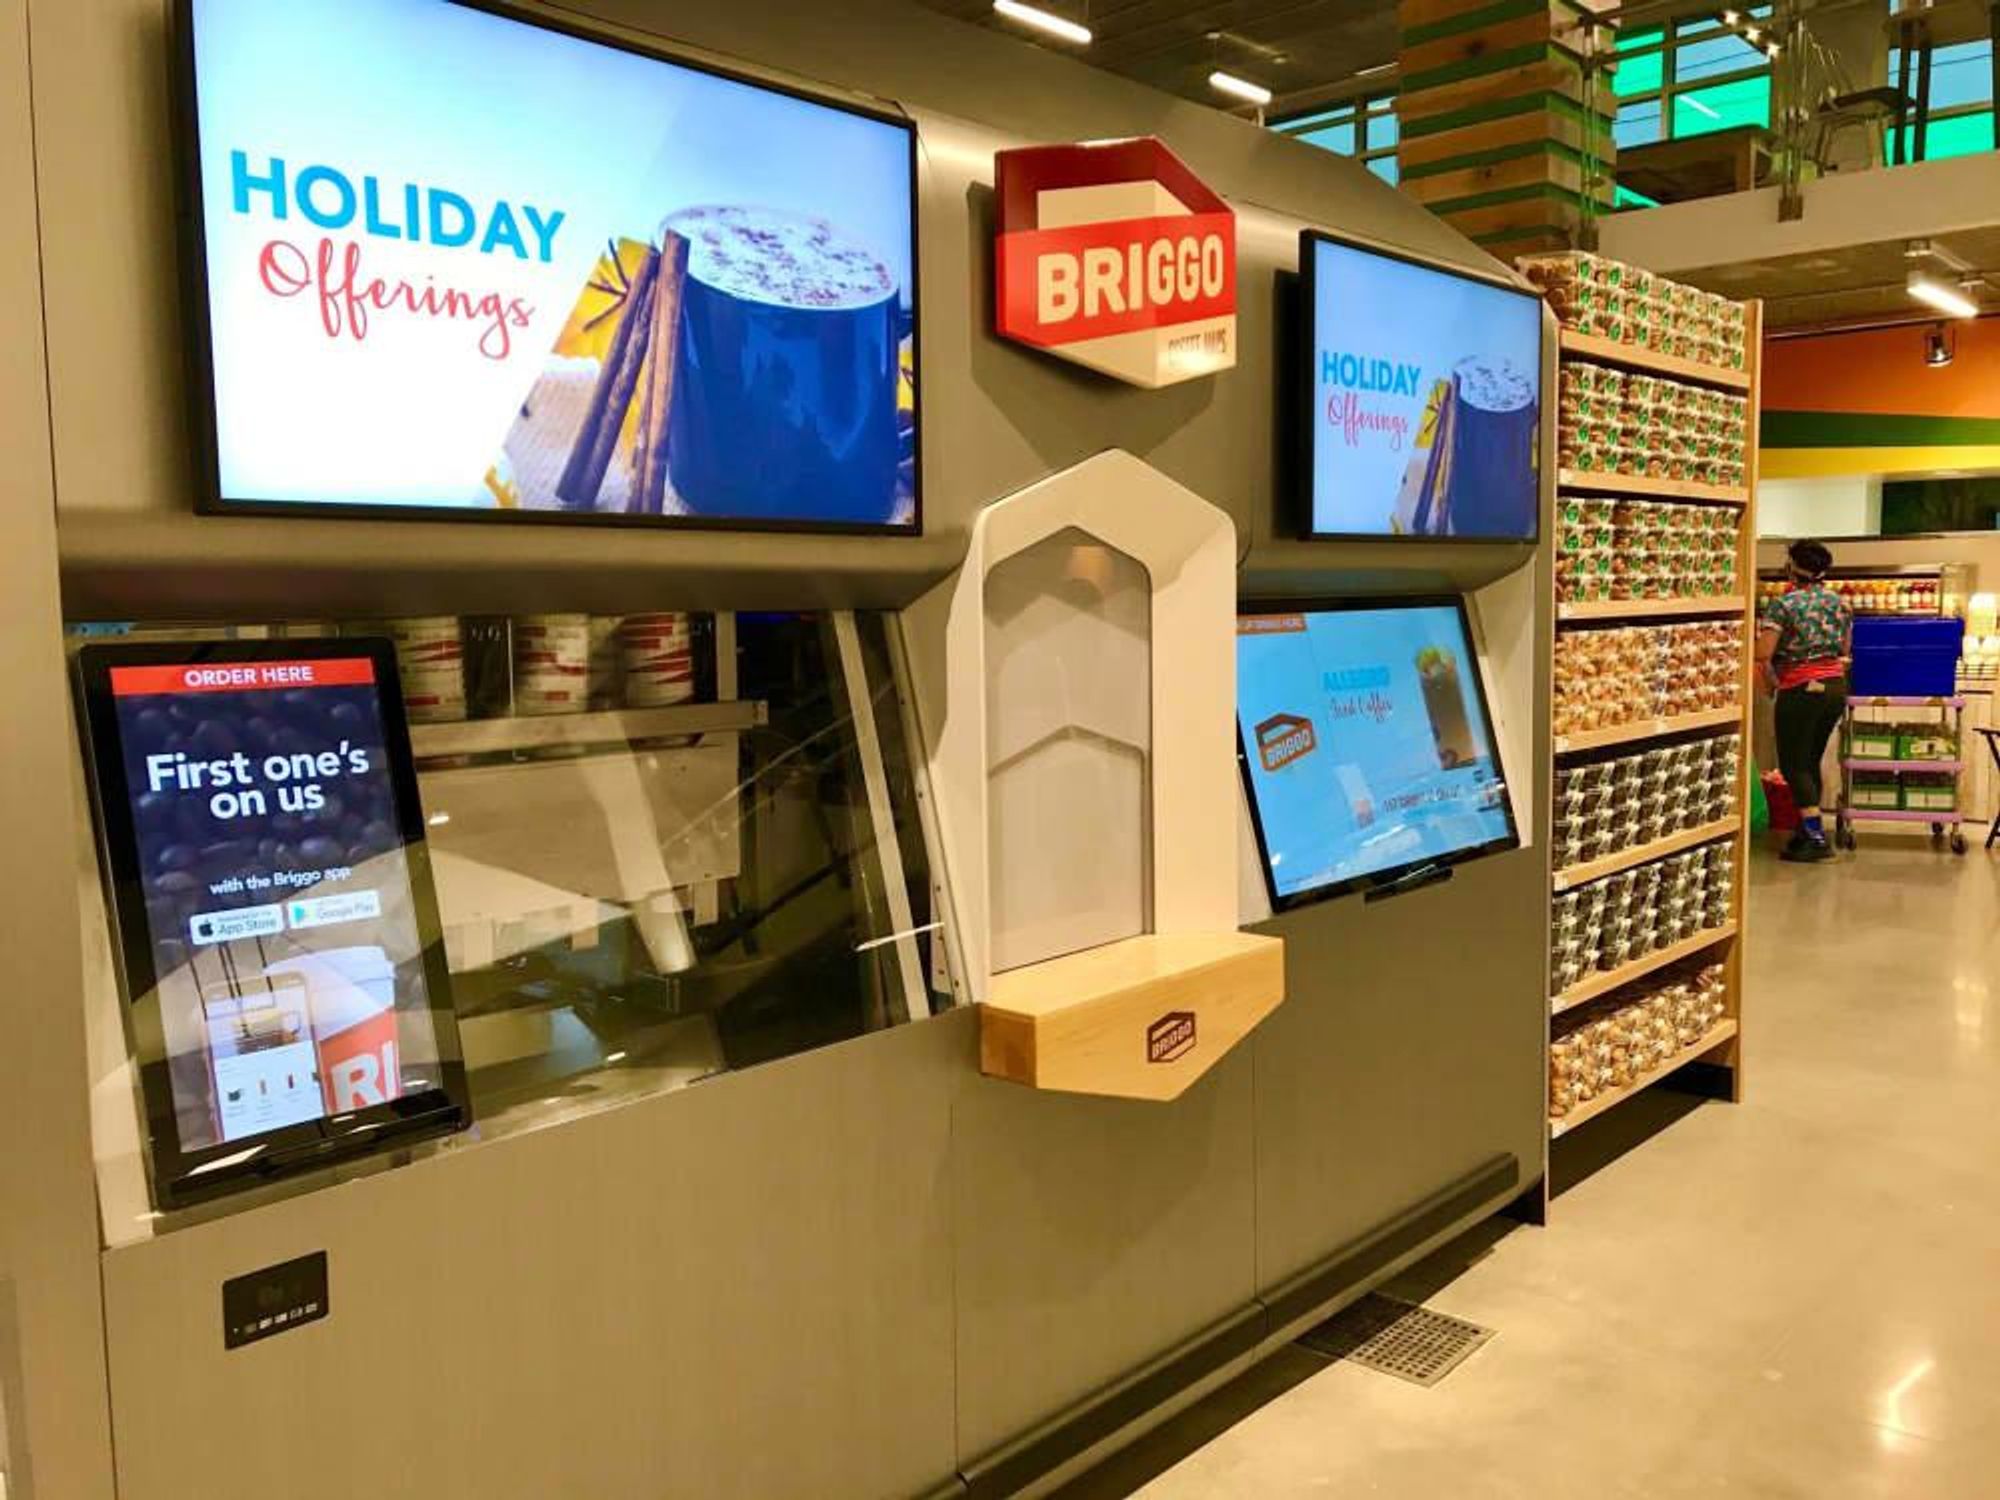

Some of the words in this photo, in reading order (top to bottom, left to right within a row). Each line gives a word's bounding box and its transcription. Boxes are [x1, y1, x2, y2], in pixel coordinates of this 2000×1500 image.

[231, 149, 566, 263] HOLIDAY
[259, 237, 535, 361] Offerings
[1037, 234, 1224, 325] BRIGGO
[1322, 350, 1421, 397] HOLIDAY
[1328, 391, 1408, 451] Offerings
[185, 668, 257, 686] ORDER
[263, 666, 313, 682] HERE
[147, 752, 253, 791] First
[264, 740, 370, 781] one's
[210, 787, 267, 819] on
[278, 783, 325, 811] us
[209, 877, 243, 894] with
[246, 874, 270, 889] the
[273, 870, 321, 887] Briggo
[218, 923, 244, 935] App
[246, 918, 277, 931] Store
